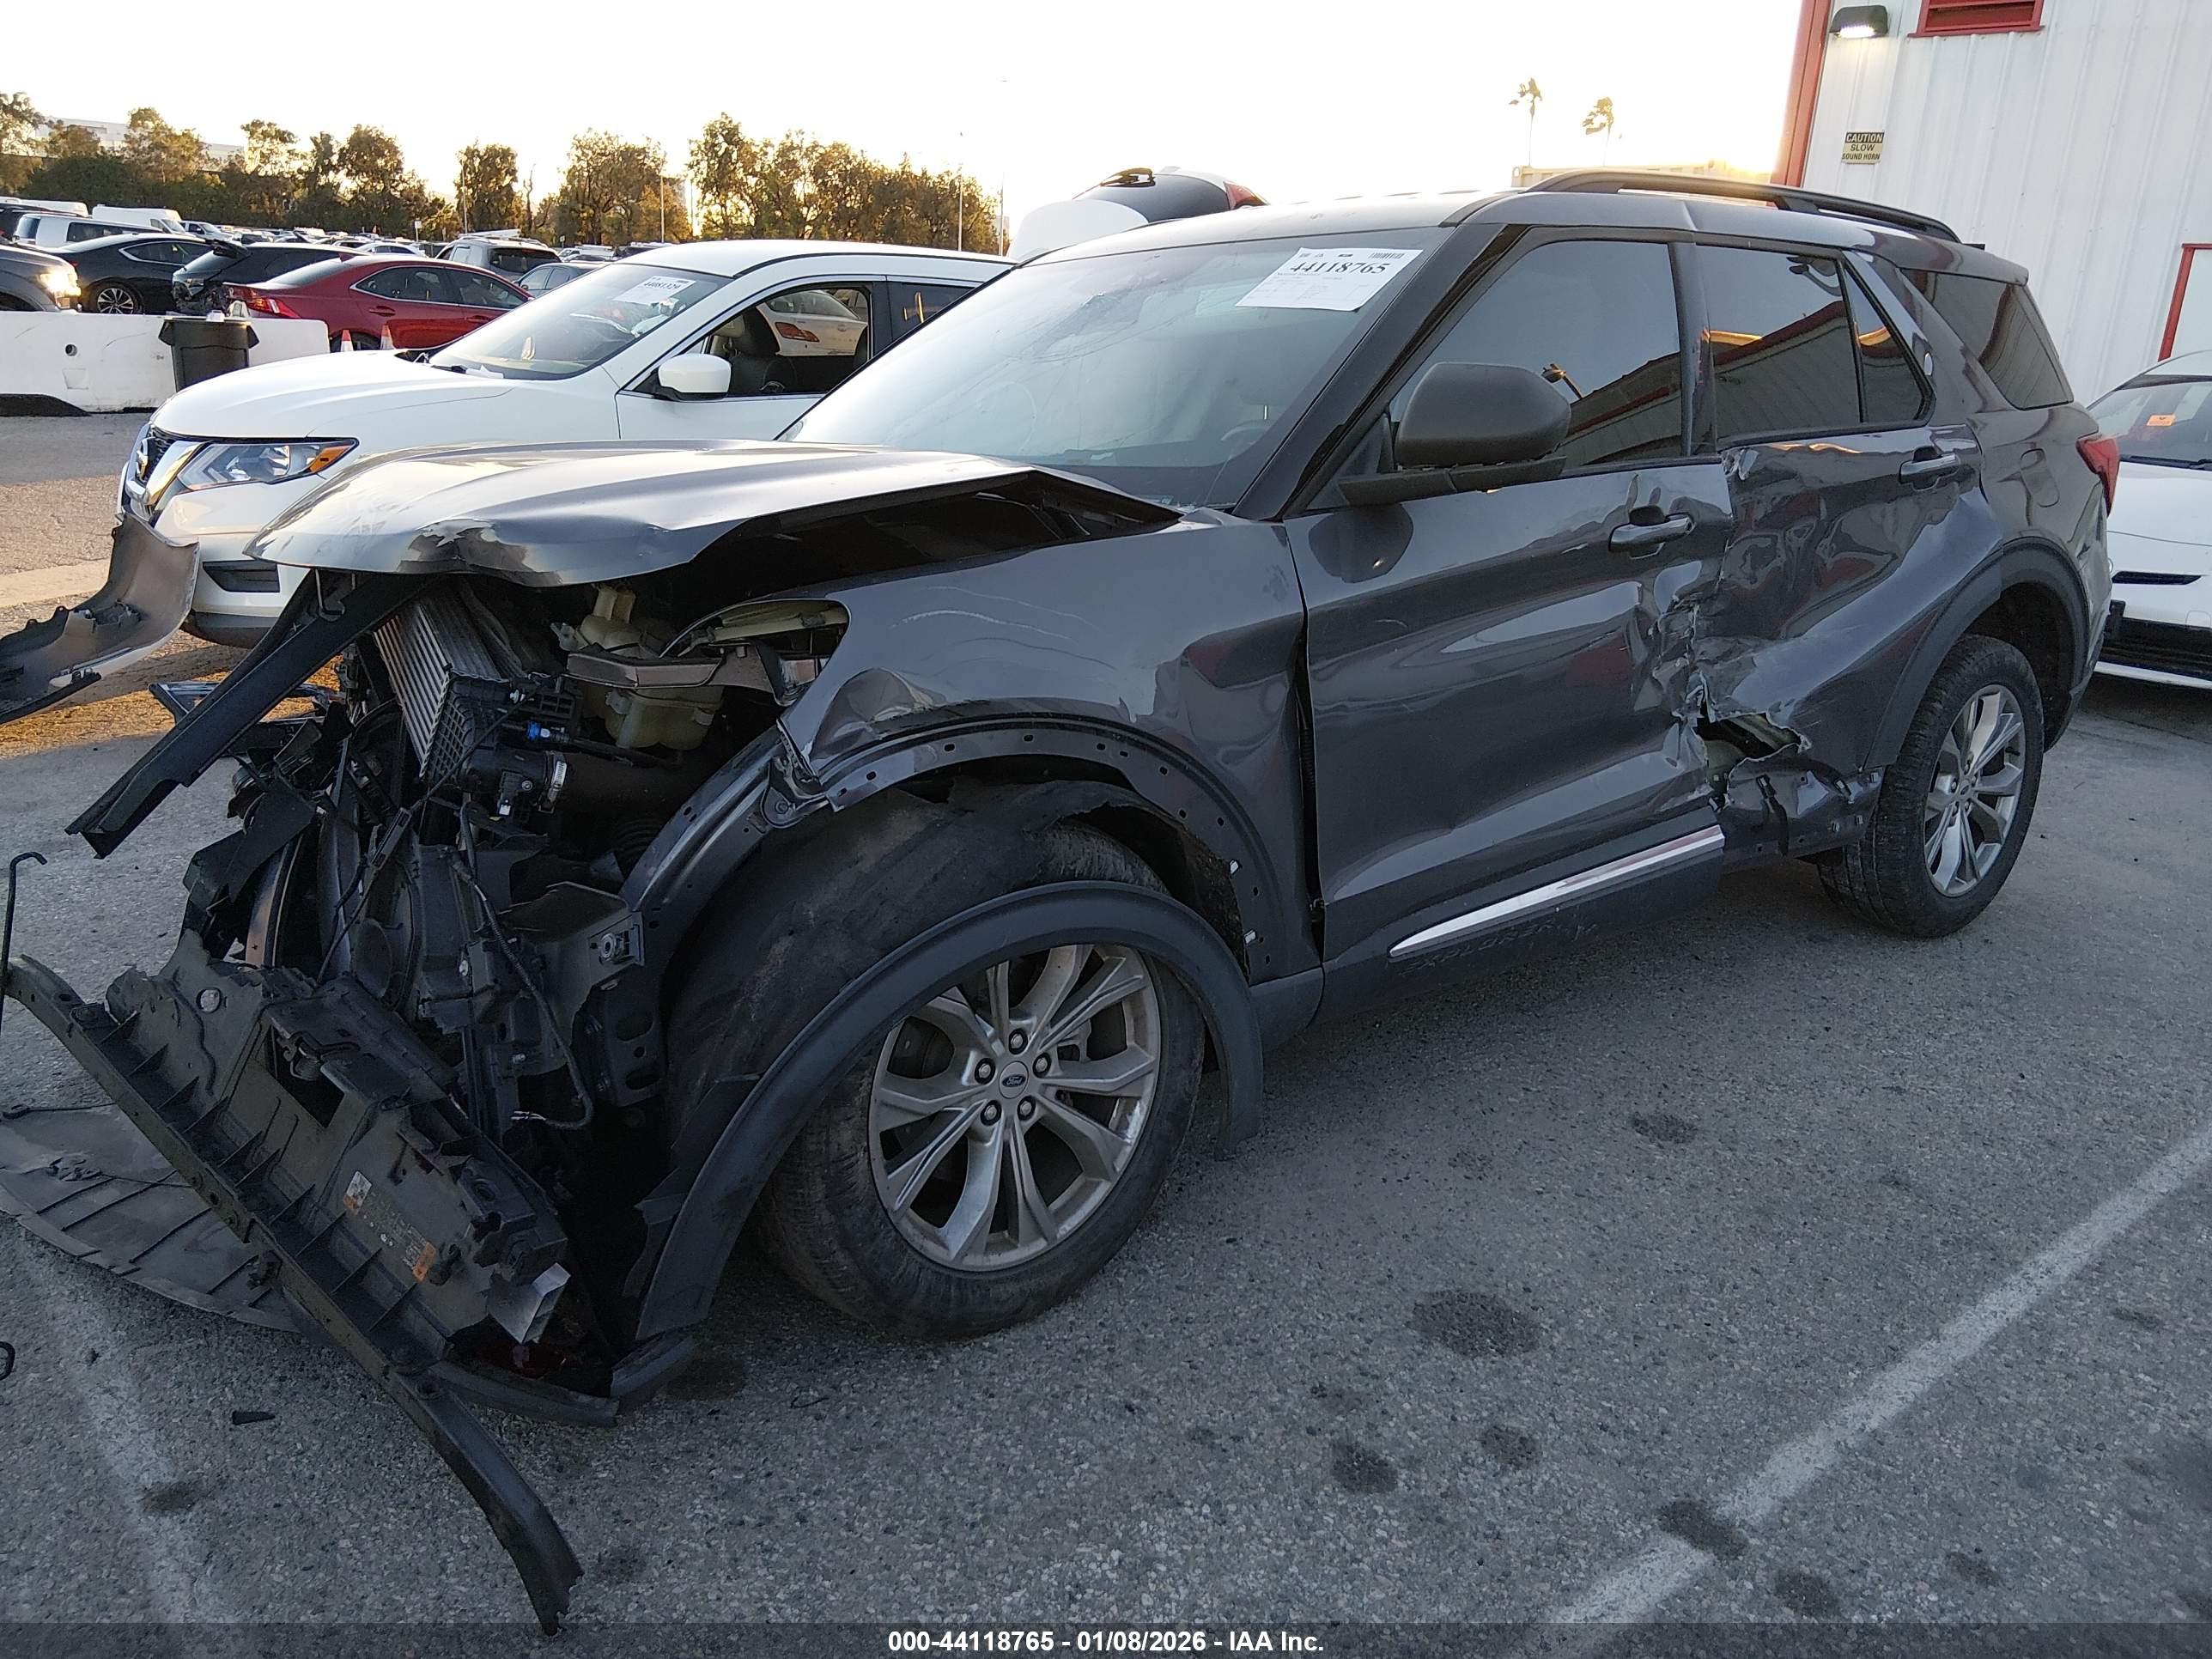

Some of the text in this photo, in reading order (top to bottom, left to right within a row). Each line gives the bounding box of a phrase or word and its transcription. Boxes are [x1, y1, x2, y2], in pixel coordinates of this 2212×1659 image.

[1846, 133, 1883, 143] CAUTION
[1850, 143, 1875, 152] SLOW
[1290, 261, 1390, 274] 44118765
